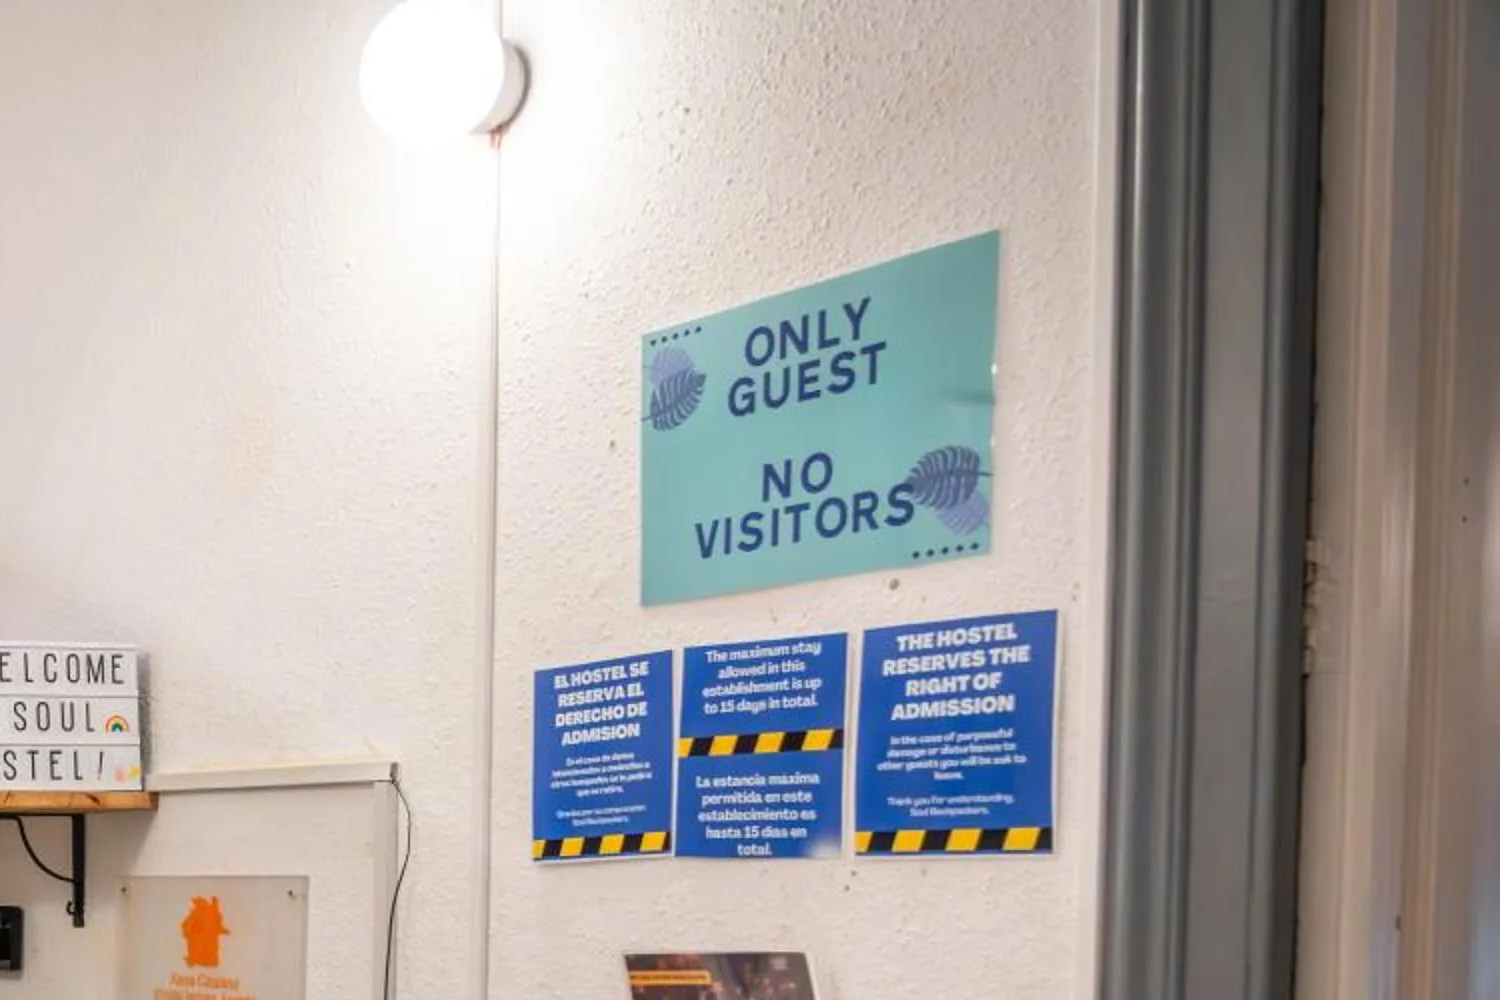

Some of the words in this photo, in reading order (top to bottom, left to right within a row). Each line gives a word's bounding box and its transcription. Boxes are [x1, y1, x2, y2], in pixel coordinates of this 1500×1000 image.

[745, 297, 871, 366] ONLY
[728, 341, 887, 417] GUEST
[762, 452, 833, 501] NO
[695, 483, 915, 559] VISITORS
[897, 632, 934, 651] THE
[936, 623, 1018, 648] HOSTEL
[705, 650, 728, 663] The
[729, 646, 790, 661] maximum
[792, 642, 822, 656] stay
[882, 651, 986, 676] RESERVES
[989, 645, 1031, 665] THE
[554, 675, 568, 689] EL
[570, 665, 627, 686] HOSTEL
[629, 661, 650, 677] SE
[718, 664, 766, 679] allowed
[768, 661, 780, 674] in
[781, 660, 805, 673] this
[558, 687, 625, 707] RESERVA
[627, 683, 644, 697] EL
[702, 680, 790, 698] establishment
[792, 678, 803, 689] is
[804, 677, 822, 690] up
[905, 675, 970, 696] RIGHT
[972, 672, 1002, 690] OF
[555, 705, 625, 727] DERECHO
[627, 702, 648, 717] DE
[704, 703, 718, 714] to
[719, 701, 735, 713] 15
[737, 699, 766, 714] days
[769, 697, 781, 708] in
[783, 694, 818, 707] total.
[891, 695, 1015, 720] ADMISSION
[13, 701, 95, 732] SOUL
[561, 723, 640, 746] ADMISION
[696, 776, 711, 788] La
[713, 774, 766, 787] estancia
[701, 792, 763, 808] permitida
[764, 792, 780, 803] en
[782, 789, 812, 802] este
[698, 808, 799, 822] establecimiento
[800, 809, 816, 820] es
[705, 826, 741, 839] hasta
[743, 826, 759, 839] 15
[790, 826, 807, 838] en
[737, 843, 772, 856] total.
